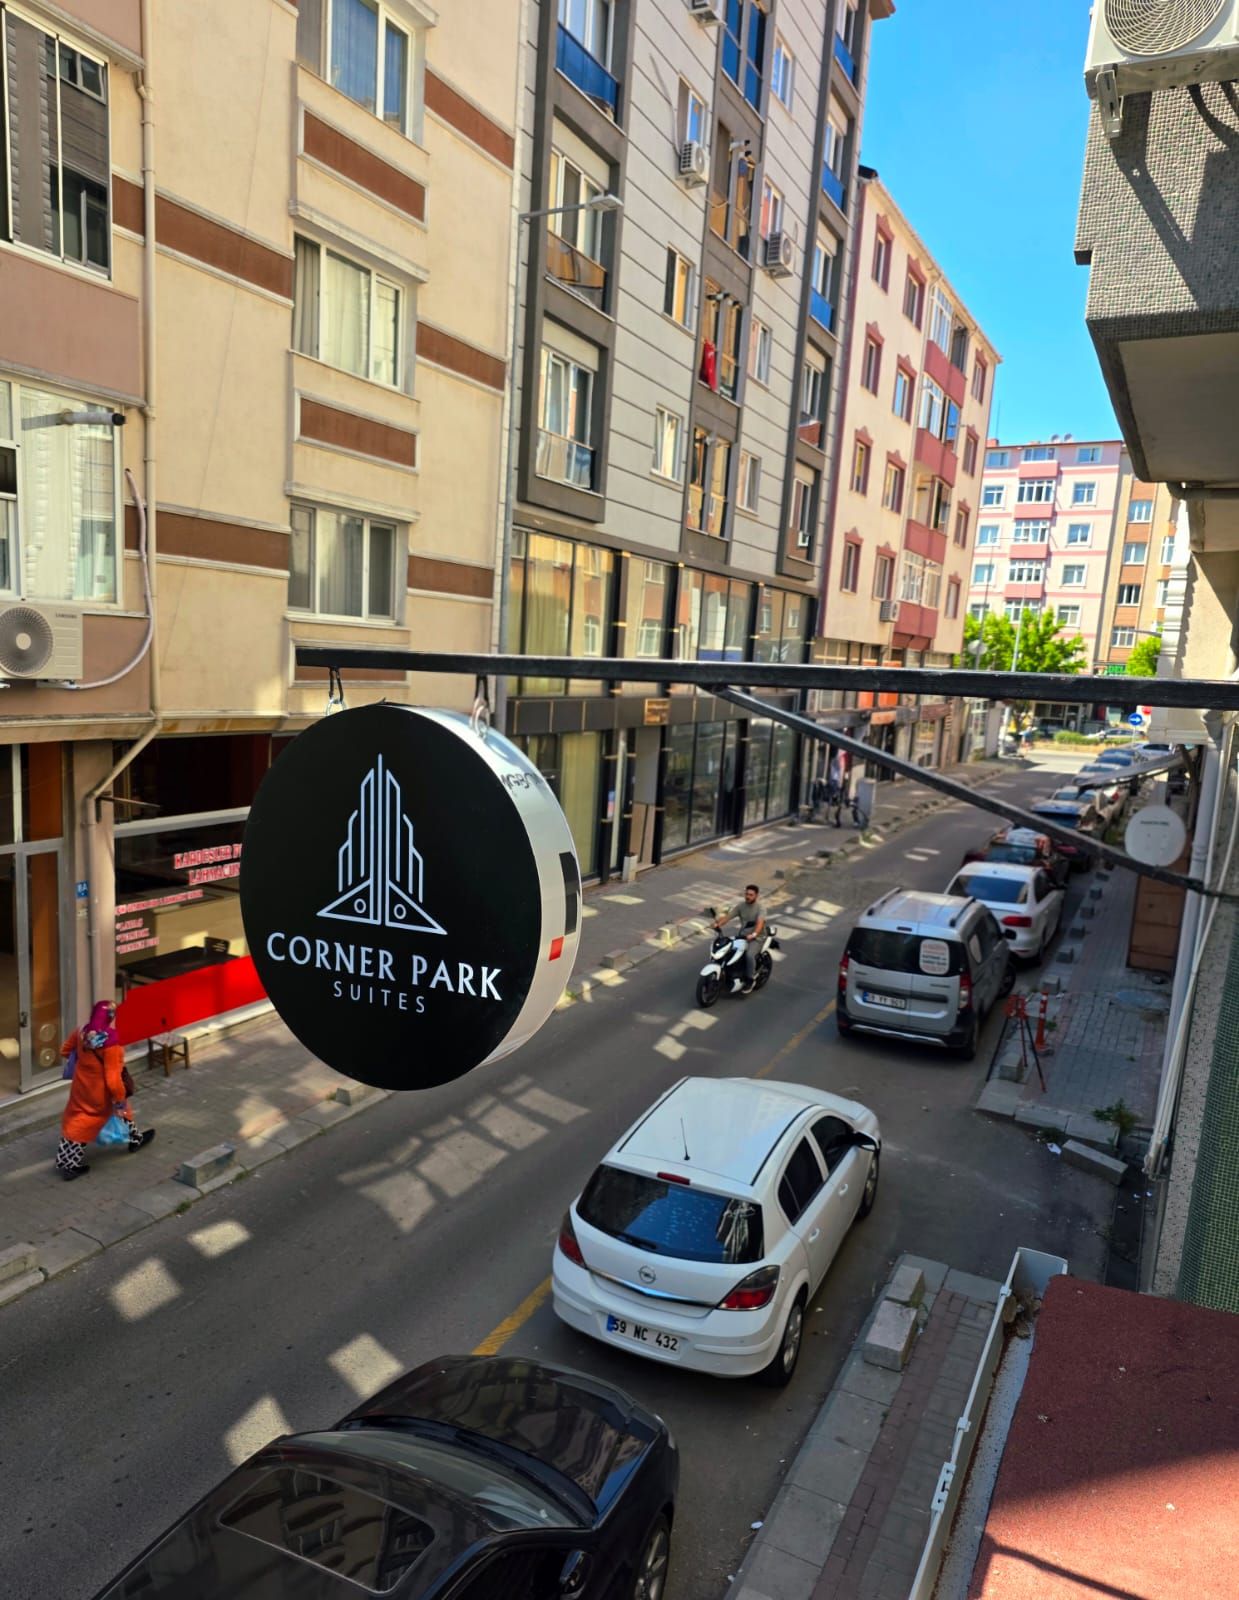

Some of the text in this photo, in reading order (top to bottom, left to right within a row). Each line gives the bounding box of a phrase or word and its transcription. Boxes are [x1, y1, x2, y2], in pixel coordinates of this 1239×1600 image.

[266, 932, 503, 1001] CORNER PARK
[333, 980, 426, 1014] SUITES
[612, 1318, 678, 1351] 59 NC 432
